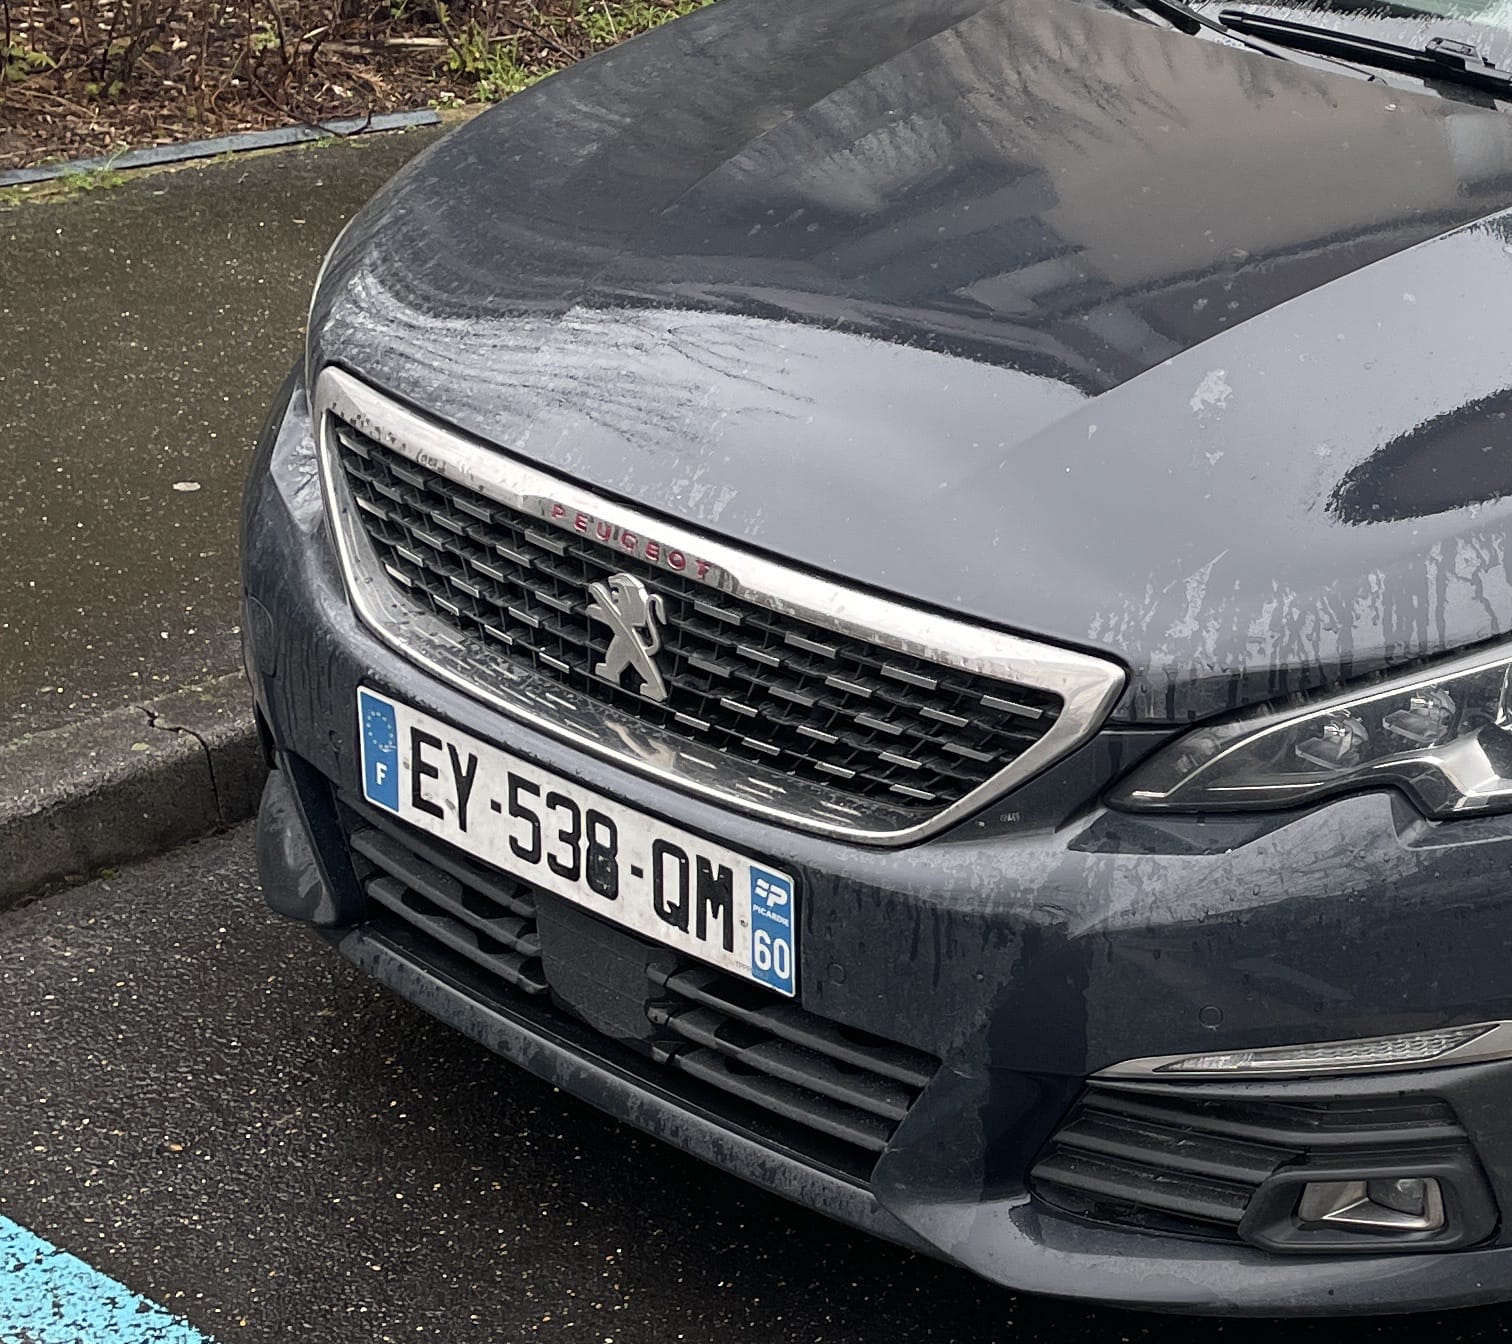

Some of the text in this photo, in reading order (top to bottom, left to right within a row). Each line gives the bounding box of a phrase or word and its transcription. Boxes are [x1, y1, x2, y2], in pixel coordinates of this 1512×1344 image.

[551, 504, 712, 580] PEUGEOT
[376, 760, 388, 786] F
[753, 929, 791, 980] 60
